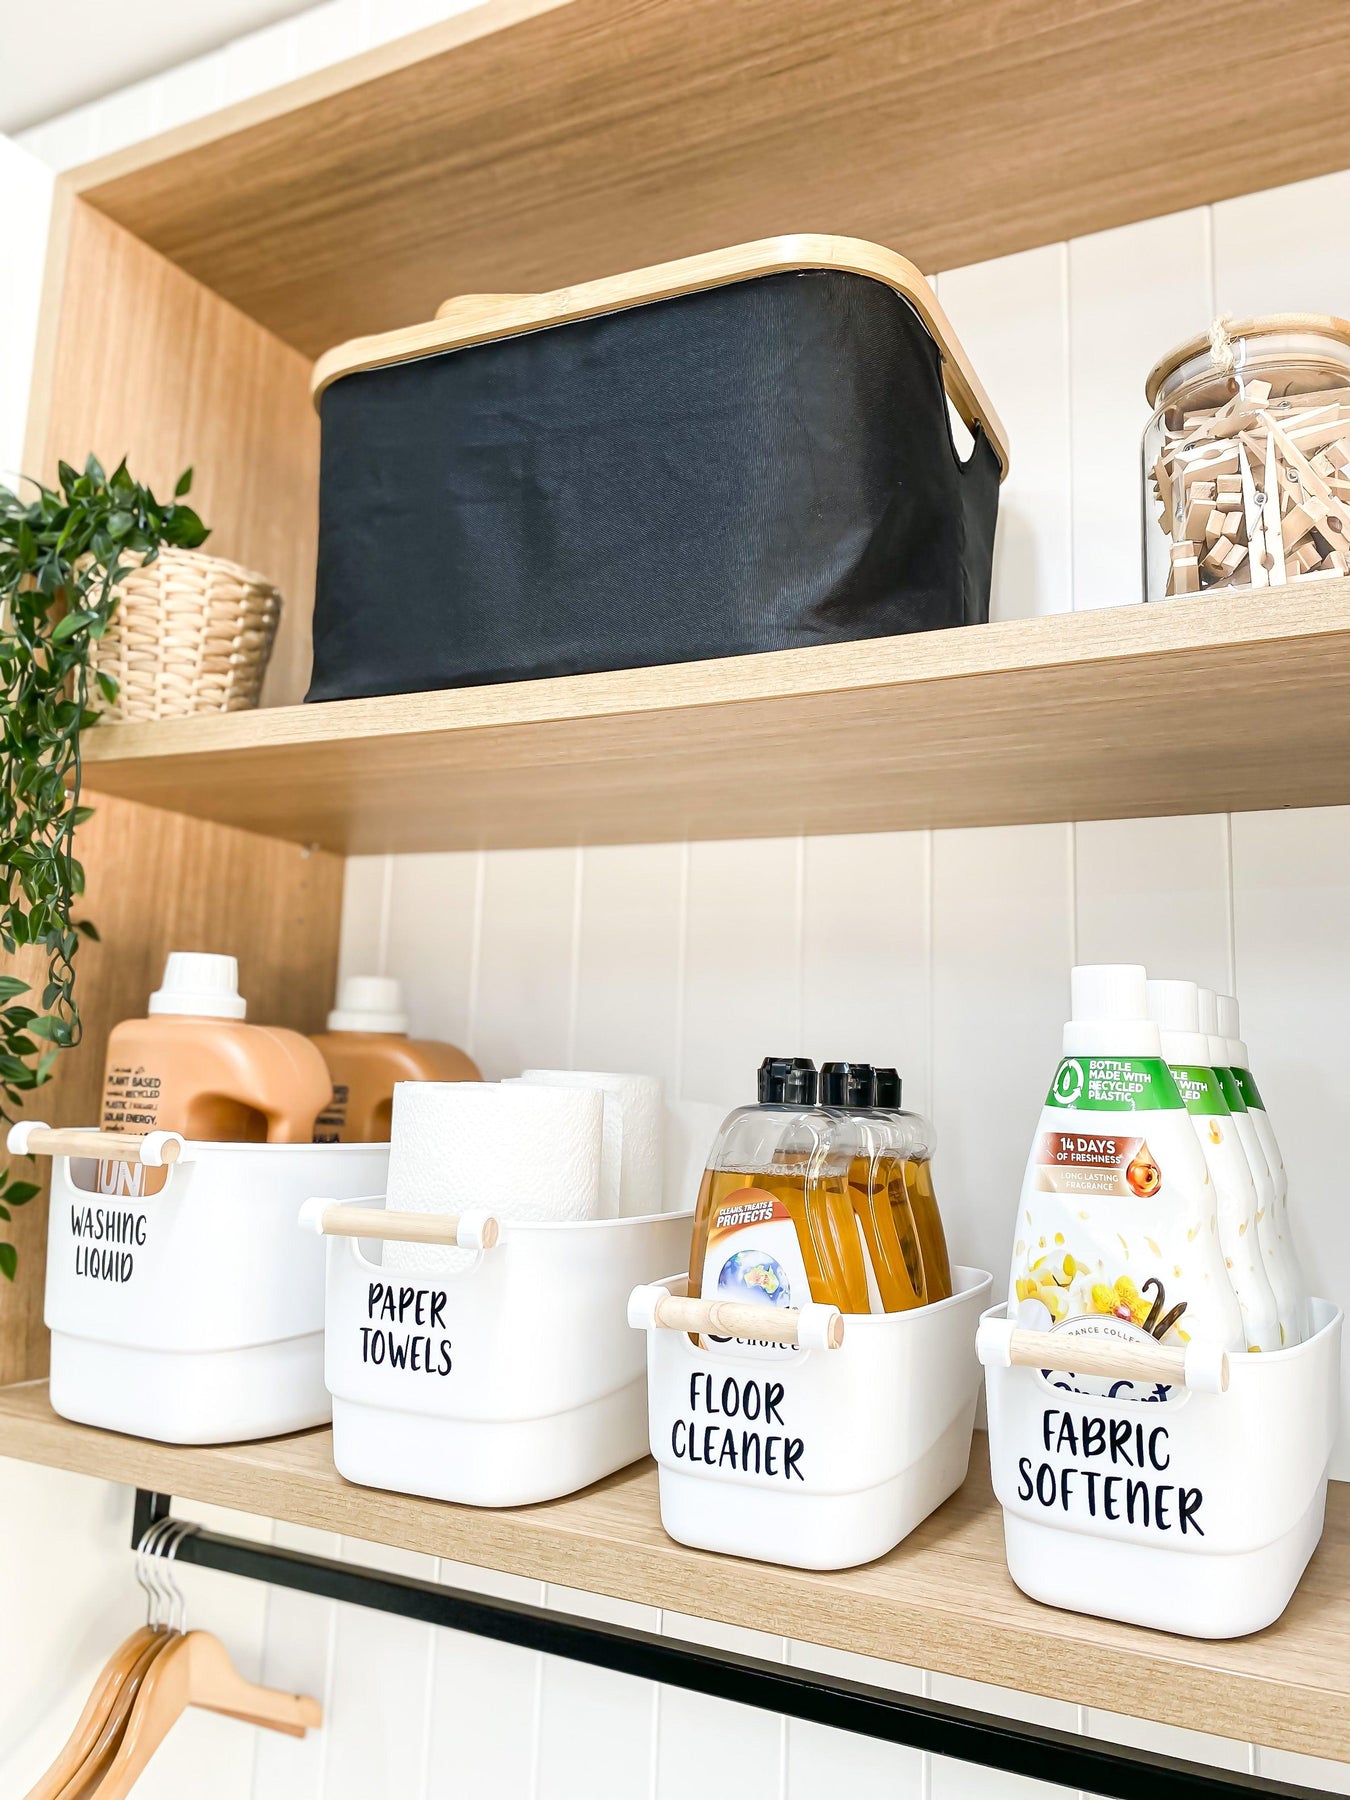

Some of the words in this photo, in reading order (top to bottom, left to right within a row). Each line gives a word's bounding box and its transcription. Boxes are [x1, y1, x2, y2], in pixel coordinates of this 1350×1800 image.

[1089, 1060, 1132, 1072] BOTTLE
[108, 1076, 130, 1086] PLANT
[132, 1076, 161, 1088] BASED
[1089, 1069, 1121, 1082] MADE
[1123, 1072, 1152, 1083] WITH
[125, 1090, 160, 1098] RECYCLED
[1088, 1080, 1144, 1093] RECYCLED
[1180, 1080, 1208, 1092] WITH
[1088, 1090, 1133, 1103] PLASTIC
[125, 1113, 157, 1126] ENERGY,
[1060, 1137, 1075, 1152] 14
[1077, 1138, 1116, 1154] DAYS
[1056, 1152, 1069, 1161] OF
[1070, 1153, 1121, 1164] FRESHNESS
[1061, 1171, 1084, 1181] LONG
[1084, 1173, 1119, 1183] LASTING
[1065, 1181, 1114, 1191] FRAGRANCE
[719, 1205, 744, 1216] CLEANS,
[744, 1201, 768, 1212] TREATS
[767, 1200, 773, 1208] &
[71, 1204, 147, 1246] WASHING
[716, 1207, 774, 1228] PROTECTS
[76, 1244, 134, 1284] LIQUID
[368, 1282, 447, 1330] PAPER
[1103, 1327, 1141, 1343] COLLE
[359, 1326, 452, 1377] TOWELS
[690, 1371, 785, 1426] FLOOR
[1043, 1409, 1170, 1471] FABRIC
[671, 1419, 805, 1481] CLEANER
[1018, 1457, 1205, 1536] SOFTENER
